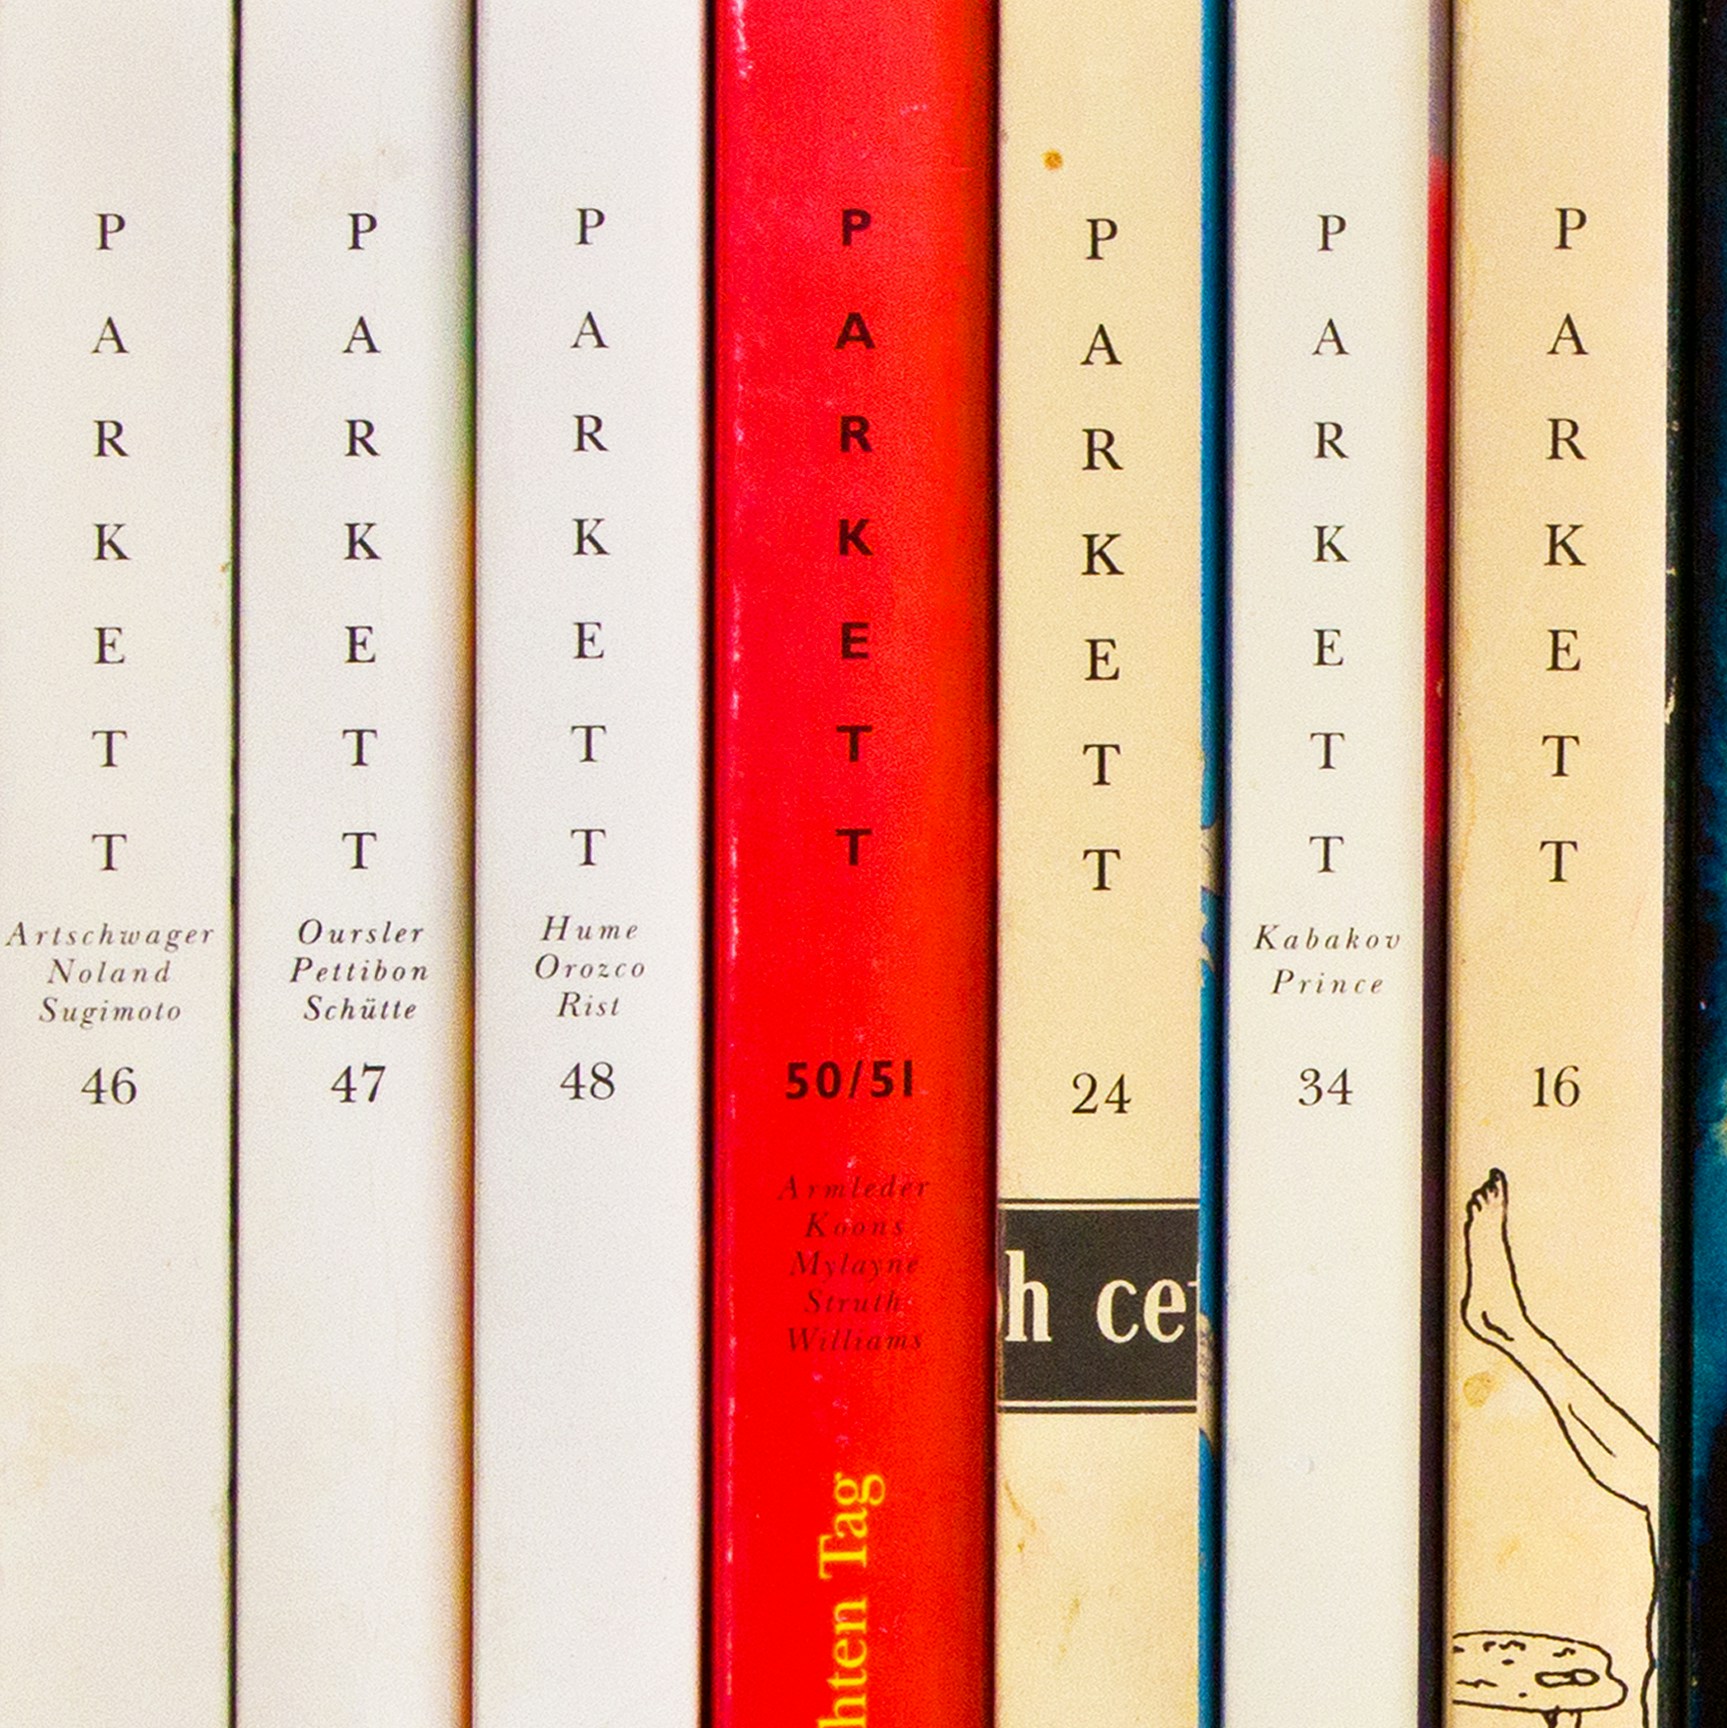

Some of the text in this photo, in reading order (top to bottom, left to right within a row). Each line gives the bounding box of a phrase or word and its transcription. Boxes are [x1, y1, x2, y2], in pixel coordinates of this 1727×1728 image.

[91, 213, 129, 872] PARKETT
[341, 212, 380, 870] PARKETT
[570, 207, 608, 867] PARKETT
[835, 208, 875, 866] PARKETT
[1081, 218, 1124, 892] PARKETT
[1309, 214, 1348, 873] PARKETT
[1539, 207, 1588, 883] PARKETT
[5, 921, 213, 952] Artschwager
[297, 918, 423, 944] Oursler
[541, 914, 637, 942] Hume
[1253, 924, 1401, 952] Kabakov
[47, 958, 171, 985] Noland
[289, 956, 427, 984] Pettibon
[534, 954, 645, 979] Orozco
[1271, 968, 1383, 995] Prince
[38, 996, 182, 1029] Sugimoto
[303, 994, 416, 1021] Schütte
[557, 991, 619, 1018] Rist
[81, 1066, 137, 1105] 46
[330, 1063, 386, 1103] 47
[560, 1062, 616, 1100] 48
[785, 1059, 913, 1100] 50/51
[1071, 1073, 1131, 1115] 24
[1298, 1068, 1352, 1106] 34
[1534, 1065, 1581, 1108] 16
[777, 1174, 929, 1201] Armleder
[804, 1212, 903, 1238] Koons
[804, 1289, 899, 1313] Struth
[1096, 1278, 1200, 1344] ce
[788, 1328, 922, 1352] Williams
[818, 1471, 885, 1580] Tag
